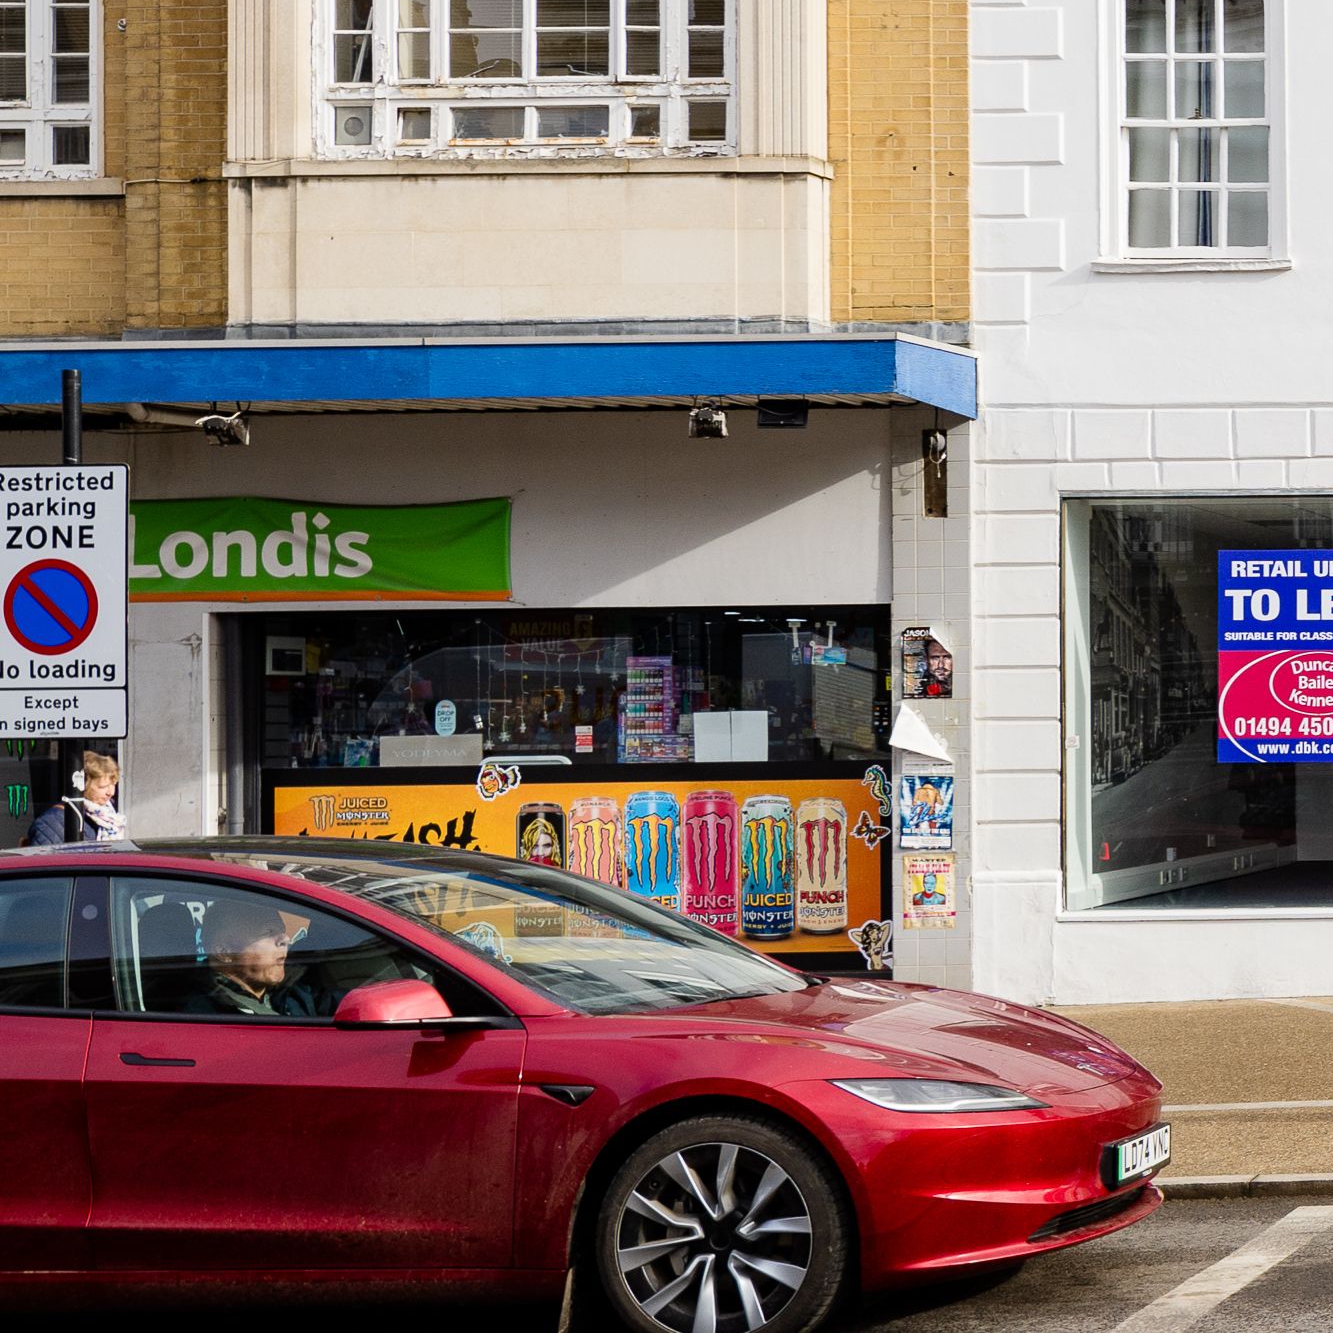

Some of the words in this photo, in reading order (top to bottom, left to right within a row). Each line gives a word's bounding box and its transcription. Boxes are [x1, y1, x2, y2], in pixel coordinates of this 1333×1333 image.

[7, 497, 96, 520] parking
[6, 525, 95, 550] ZONE
[129, 511, 373, 580] Londis
[1231, 560, 1308, 578] RETAIL
[1224, 588, 1281, 622] TO
[510, 621, 571, 636] AMAZING
[1224, 632, 1274, 641] SUITABLE
[1276, 632, 1297, 641] FOR
[1299, 632, 1333, 641] CLASS
[521, 637, 565, 652] VALUE
[30, 659, 116, 682] loading
[24, 696, 79, 711] Except
[0, 720, 8, 731] n
[14, 717, 66, 733] signed
[72, 717, 109, 731] bays
[1234, 717, 1292, 736] 01494
[339, 797, 388, 809] JUICED
[336, 811, 390, 821] MONSTER
[686, 894, 736, 909] PUNCH
[744, 893, 792, 907] JUICED
[800, 890, 844, 904] PUNCH
[688, 910, 737, 924] ONSTER
